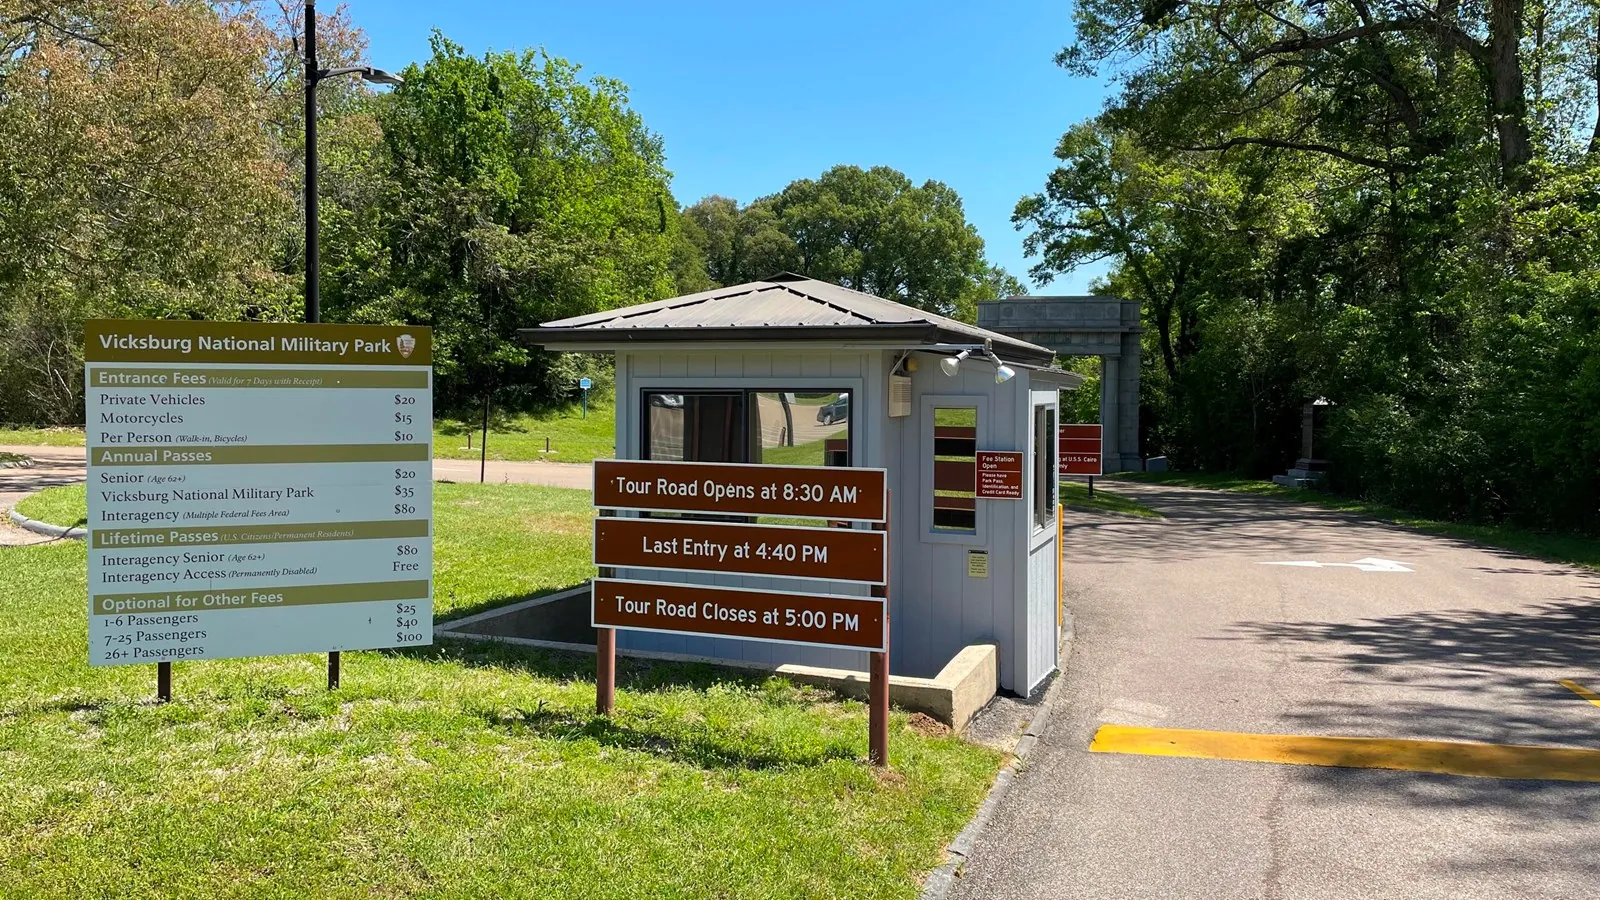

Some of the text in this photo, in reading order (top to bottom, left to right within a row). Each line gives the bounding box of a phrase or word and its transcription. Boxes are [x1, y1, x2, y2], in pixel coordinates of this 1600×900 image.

[99, 334, 391, 356] Vicksburg National Military Park
[99, 372, 168, 384] Entrance
[173, 373, 207, 385] Fees
[209, 376, 232, 385] (Valid
[233, 378, 245, 387] for
[253, 378, 273, 387] Days
[293, 378, 323, 387] Receipt)
[100, 394, 416, 405] Private Vehicles $20
[100, 412, 412, 426] Motorcycles $15
[100, 431, 413, 444] Per Person (Walk-in, Bicycles) $10
[101, 450, 212, 463] Annual Passes
[100, 469, 416, 484] Senior (Age 62+) $20
[101, 485, 414, 504] Vicksburg National Military Park $35
[616, 476, 858, 504] Tour Road Opens at 8:30 AM
[101, 510, 180, 523] Interagency
[183, 511, 219, 521] (Multiple
[268, 509, 290, 517] Area)
[394, 504, 416, 515] $80
[101, 529, 354, 545] Lifetime Passes (U.S. Citizens/Permanent Residents)
[102, 545, 418, 567] Interagency Senior (Age 62+) $80
[643, 536, 828, 564] Last Entry at 4:40 PM
[102, 561, 419, 584] Interagency Access (Permanently Disabled) Free
[102, 592, 283, 613] Optional for Other Fees
[104, 603, 416, 628] 1-6 Passengers $25
[615, 596, 860, 632] Tour Road Closes at 5:00 PM
[104, 617, 418, 647] 7-25 Passengers $40
[104, 632, 423, 660] 26+ Passengers $100
